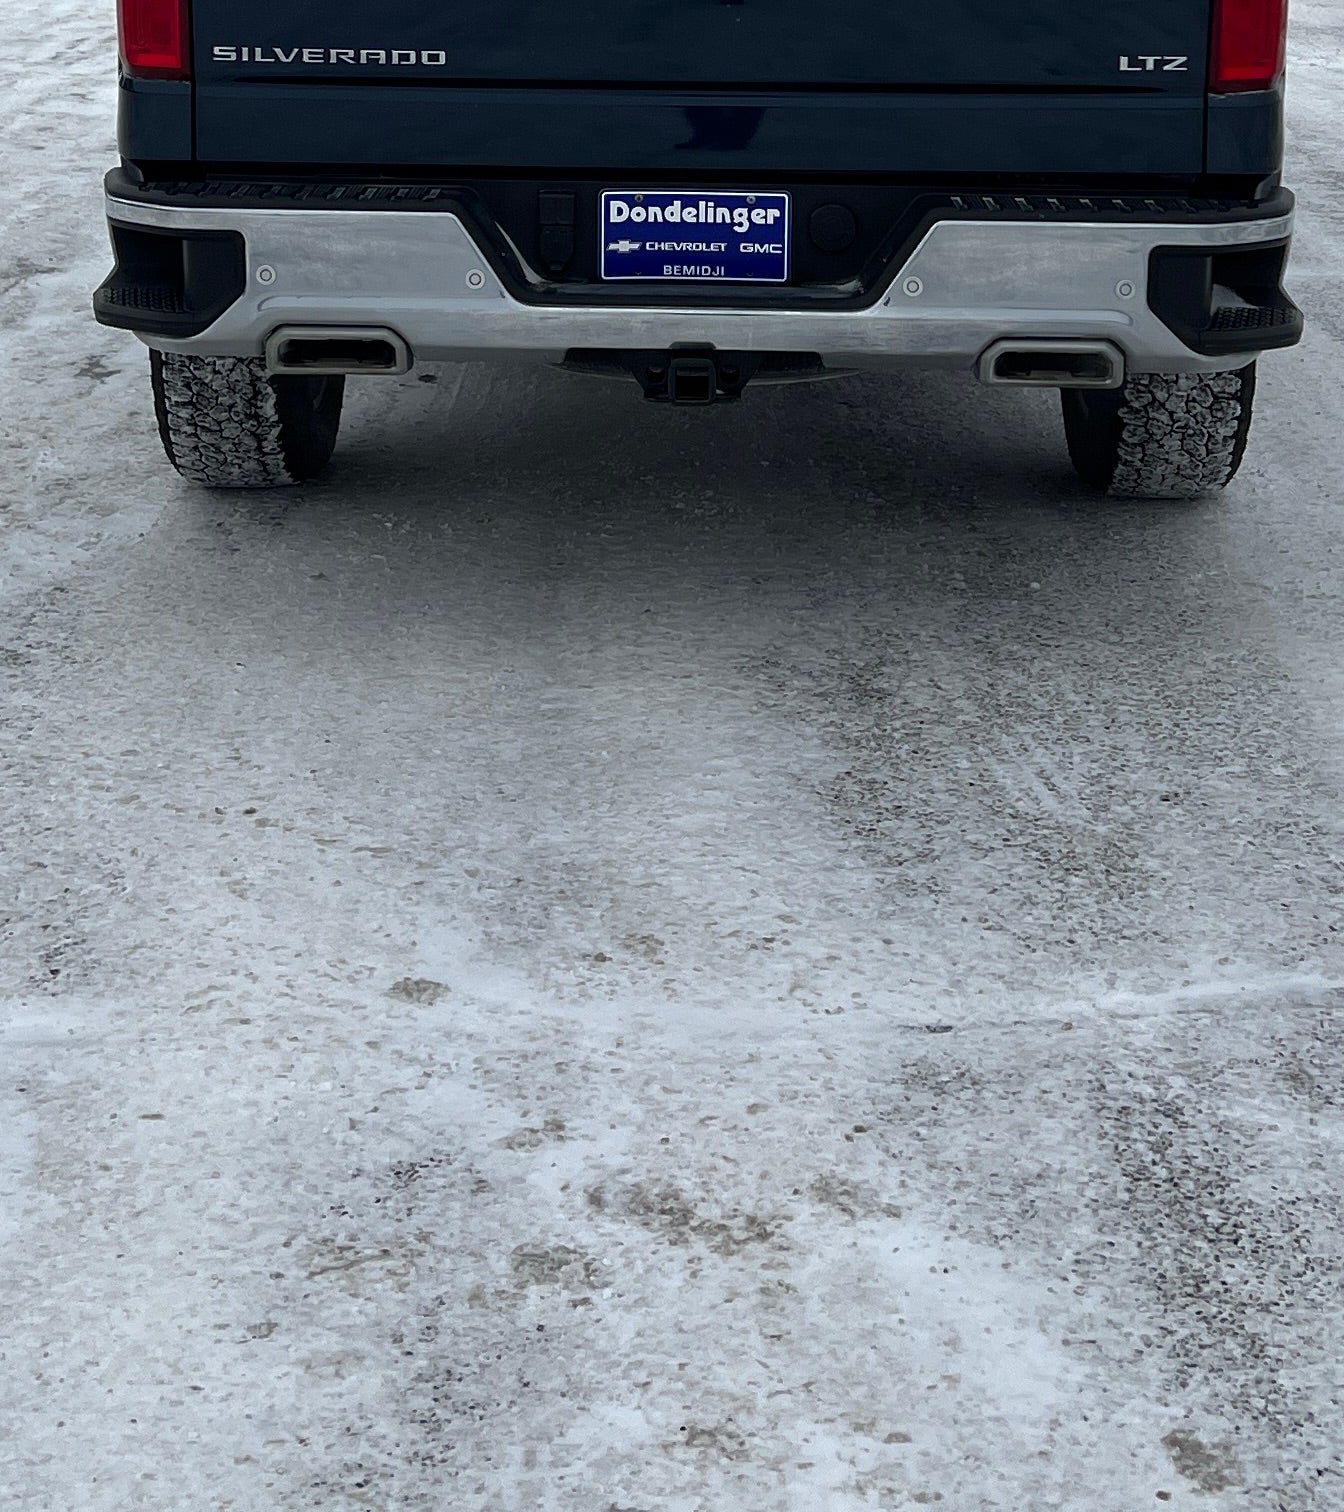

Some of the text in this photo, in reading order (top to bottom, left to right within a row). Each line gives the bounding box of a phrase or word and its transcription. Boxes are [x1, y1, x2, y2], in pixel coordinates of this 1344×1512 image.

[212, 45, 447, 66] SILVERADO
[1119, 55, 1188, 71] LTZ
[609, 200, 781, 233] Dondelinger
[645, 241, 783, 254] CHEVROLET GMC
[663, 264, 725, 277] BEMIDJI
